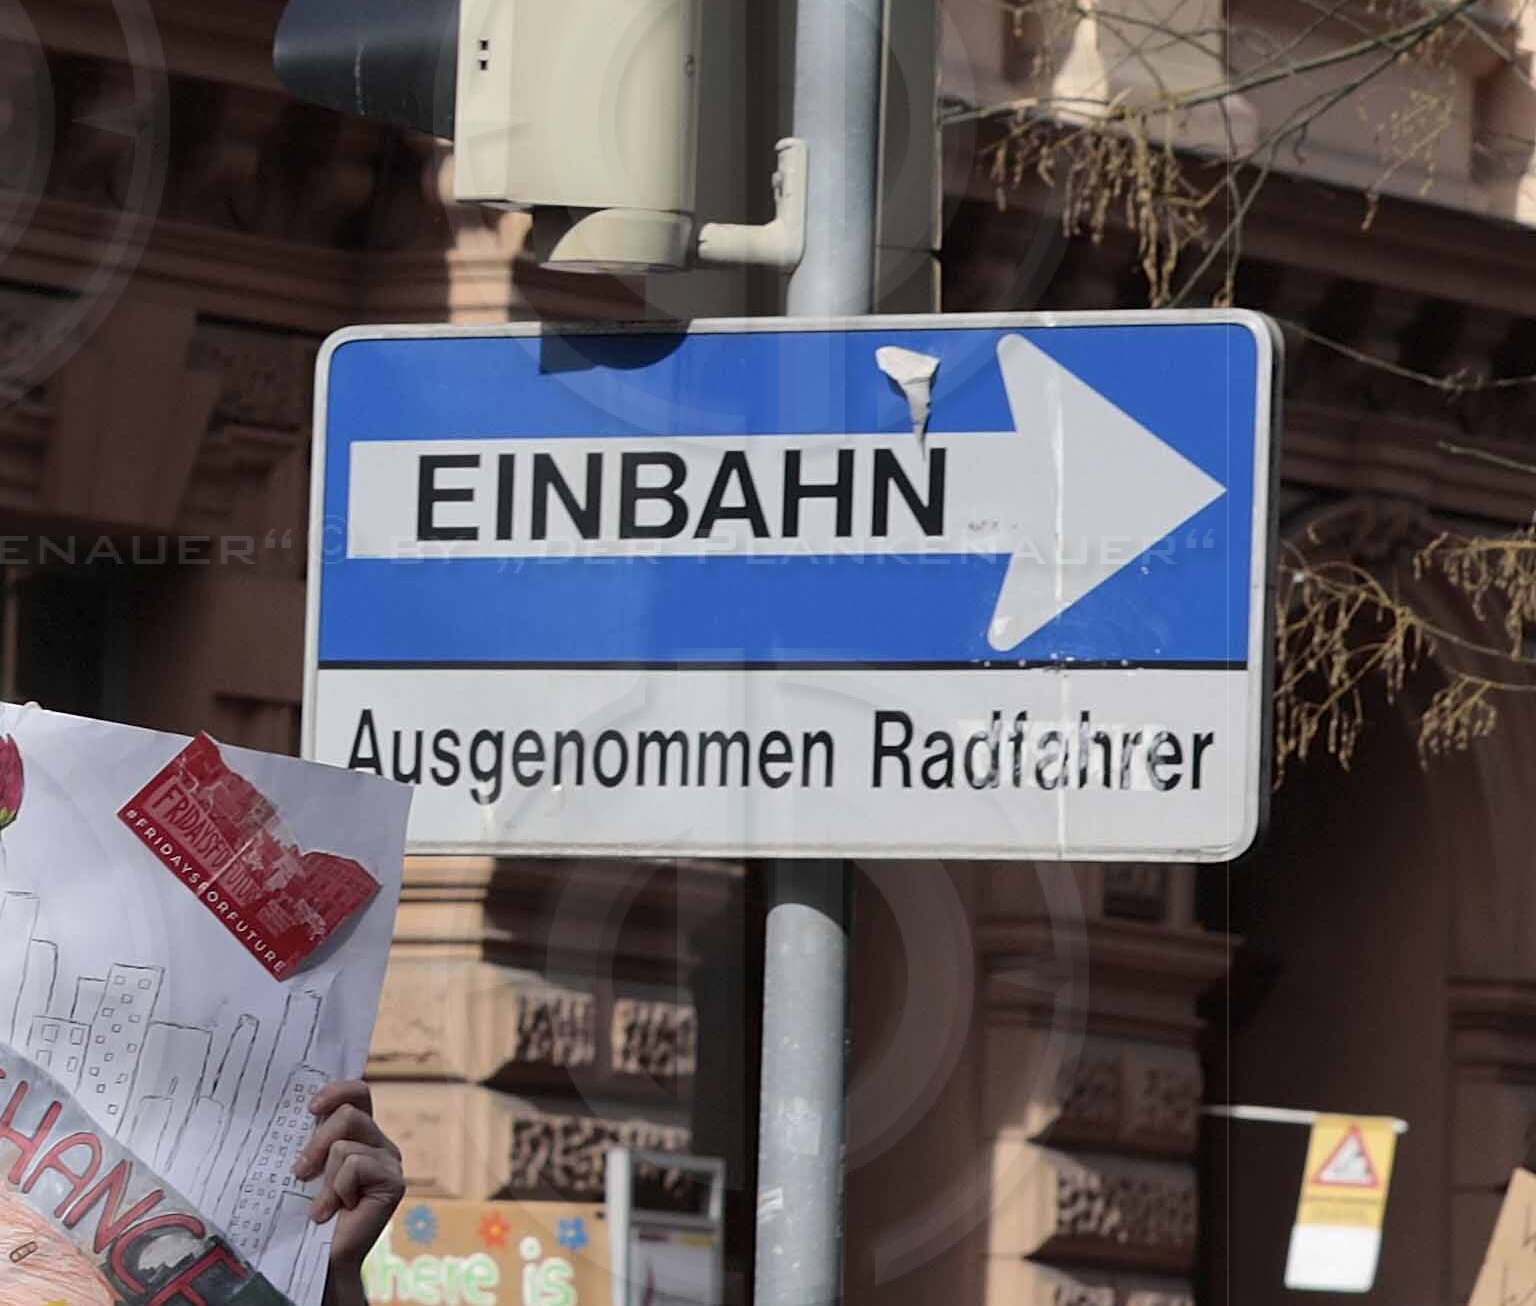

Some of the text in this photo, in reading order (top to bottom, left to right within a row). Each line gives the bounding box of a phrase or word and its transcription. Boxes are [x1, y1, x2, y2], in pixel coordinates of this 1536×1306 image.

[415, 446, 948, 542] EINBAHN
[348, 707, 1215, 806] Ausgenommen Radfahrer
[124, 808, 288, 974] #FRIDAYSFORFUTURE
